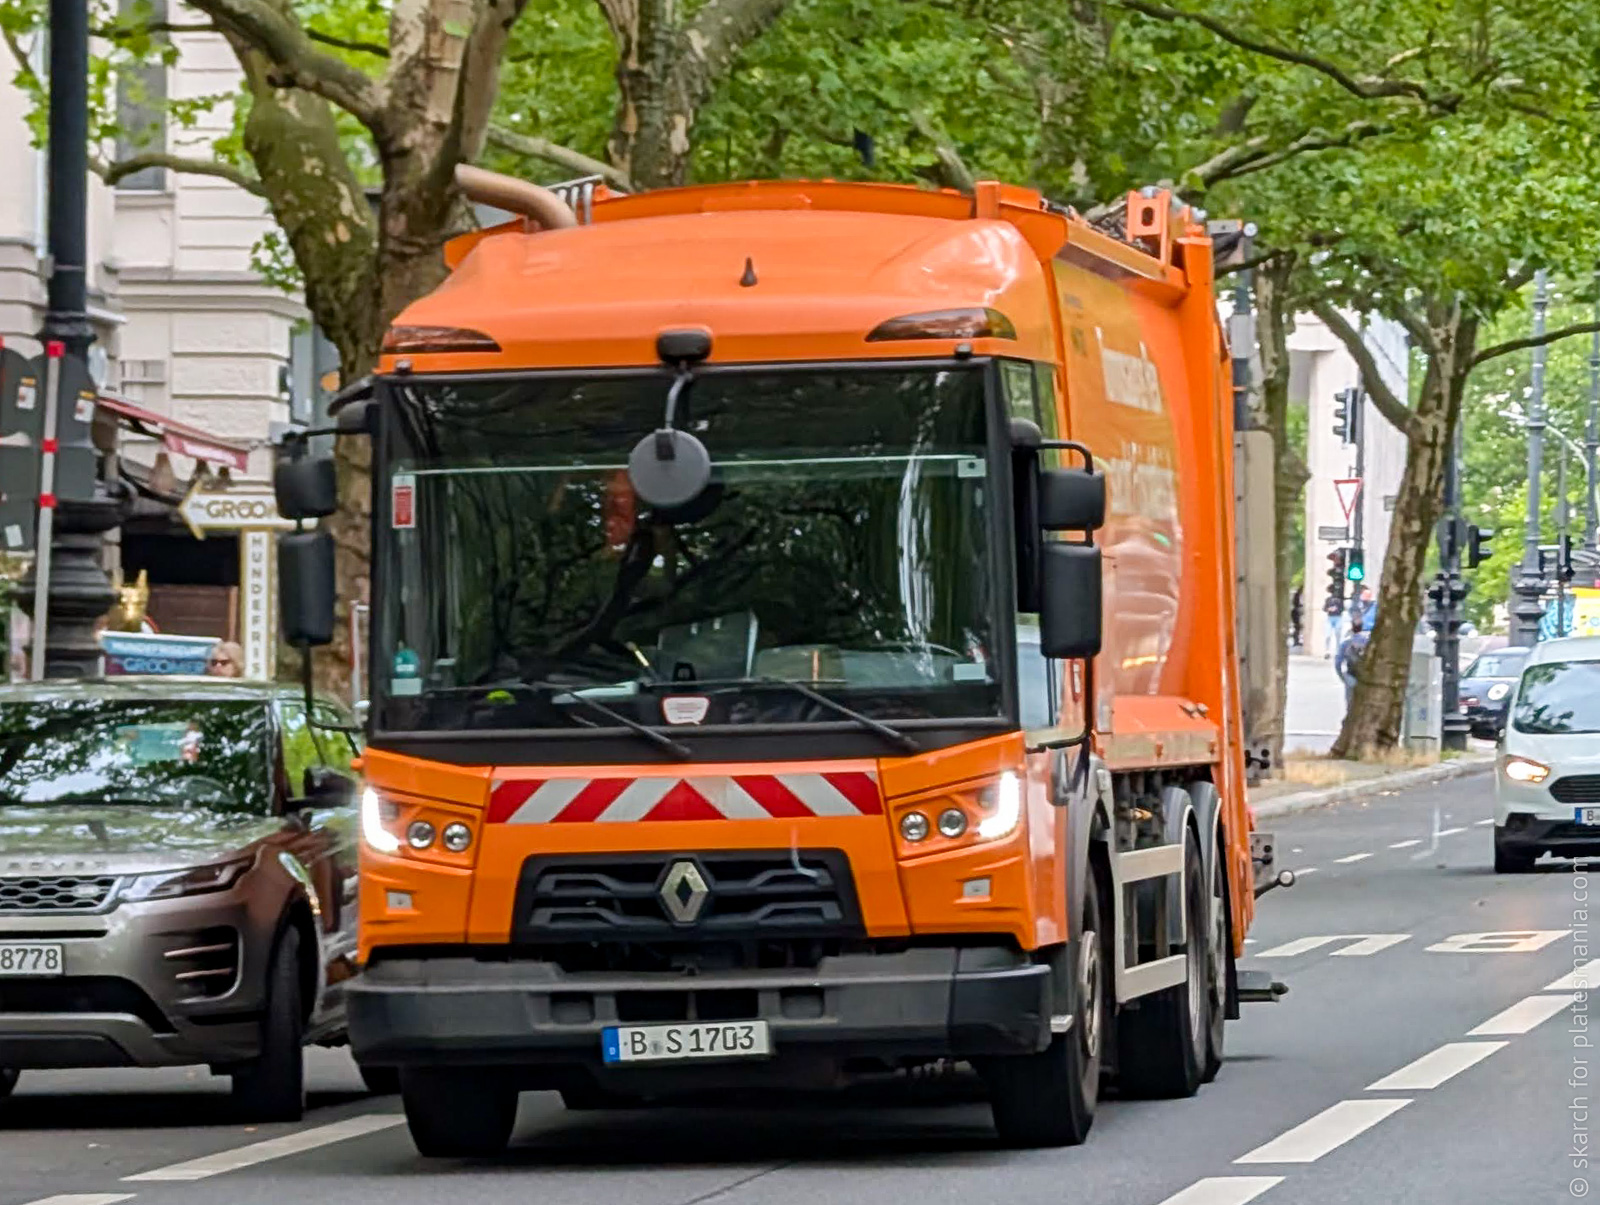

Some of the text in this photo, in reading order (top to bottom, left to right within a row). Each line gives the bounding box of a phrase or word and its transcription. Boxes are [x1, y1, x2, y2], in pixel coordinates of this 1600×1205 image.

[1250, 929, 1574, 957] BU
[0, 947, 59, 971] 8778
[630, 1031, 648, 1055] B
